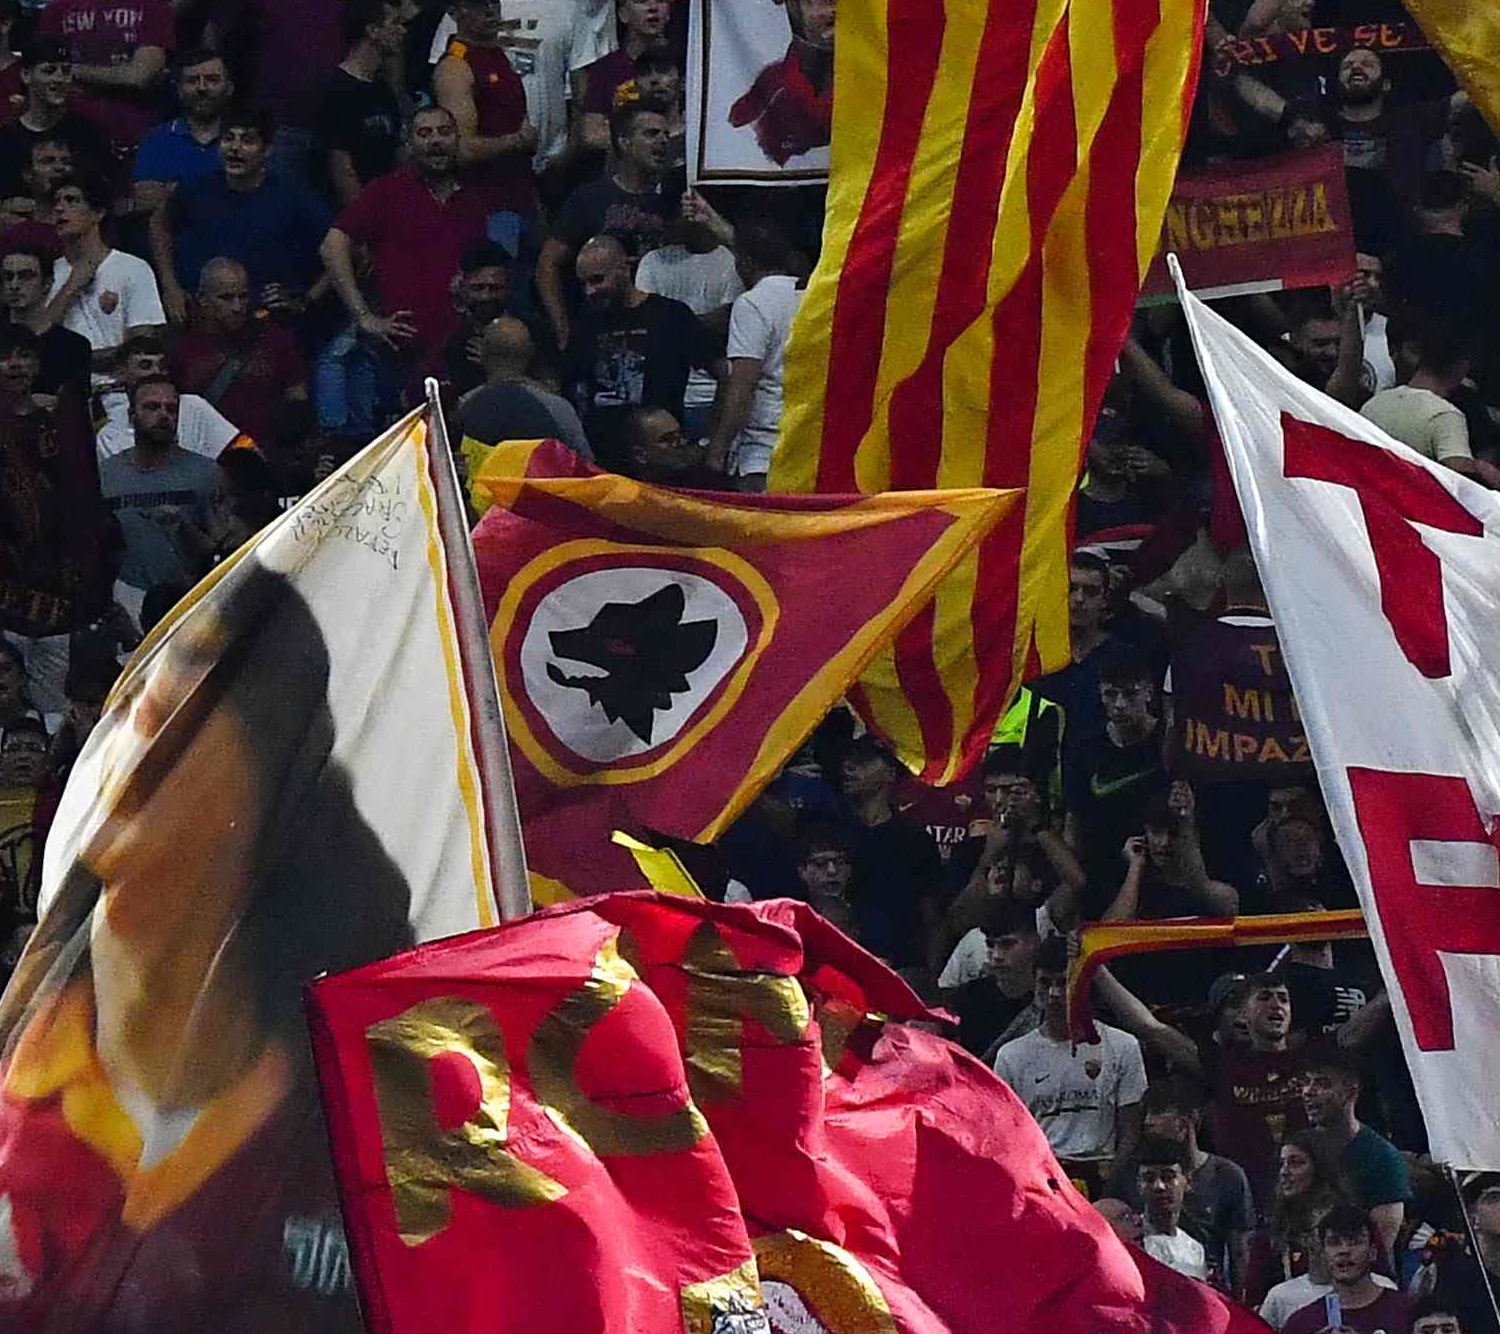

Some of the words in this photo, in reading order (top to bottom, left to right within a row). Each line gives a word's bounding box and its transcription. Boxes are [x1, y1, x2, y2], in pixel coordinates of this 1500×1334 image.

[1251, 643, 1276, 677] T
[1223, 682, 1273, 724] MI
[1186, 718, 1310, 764] IMPAZ
